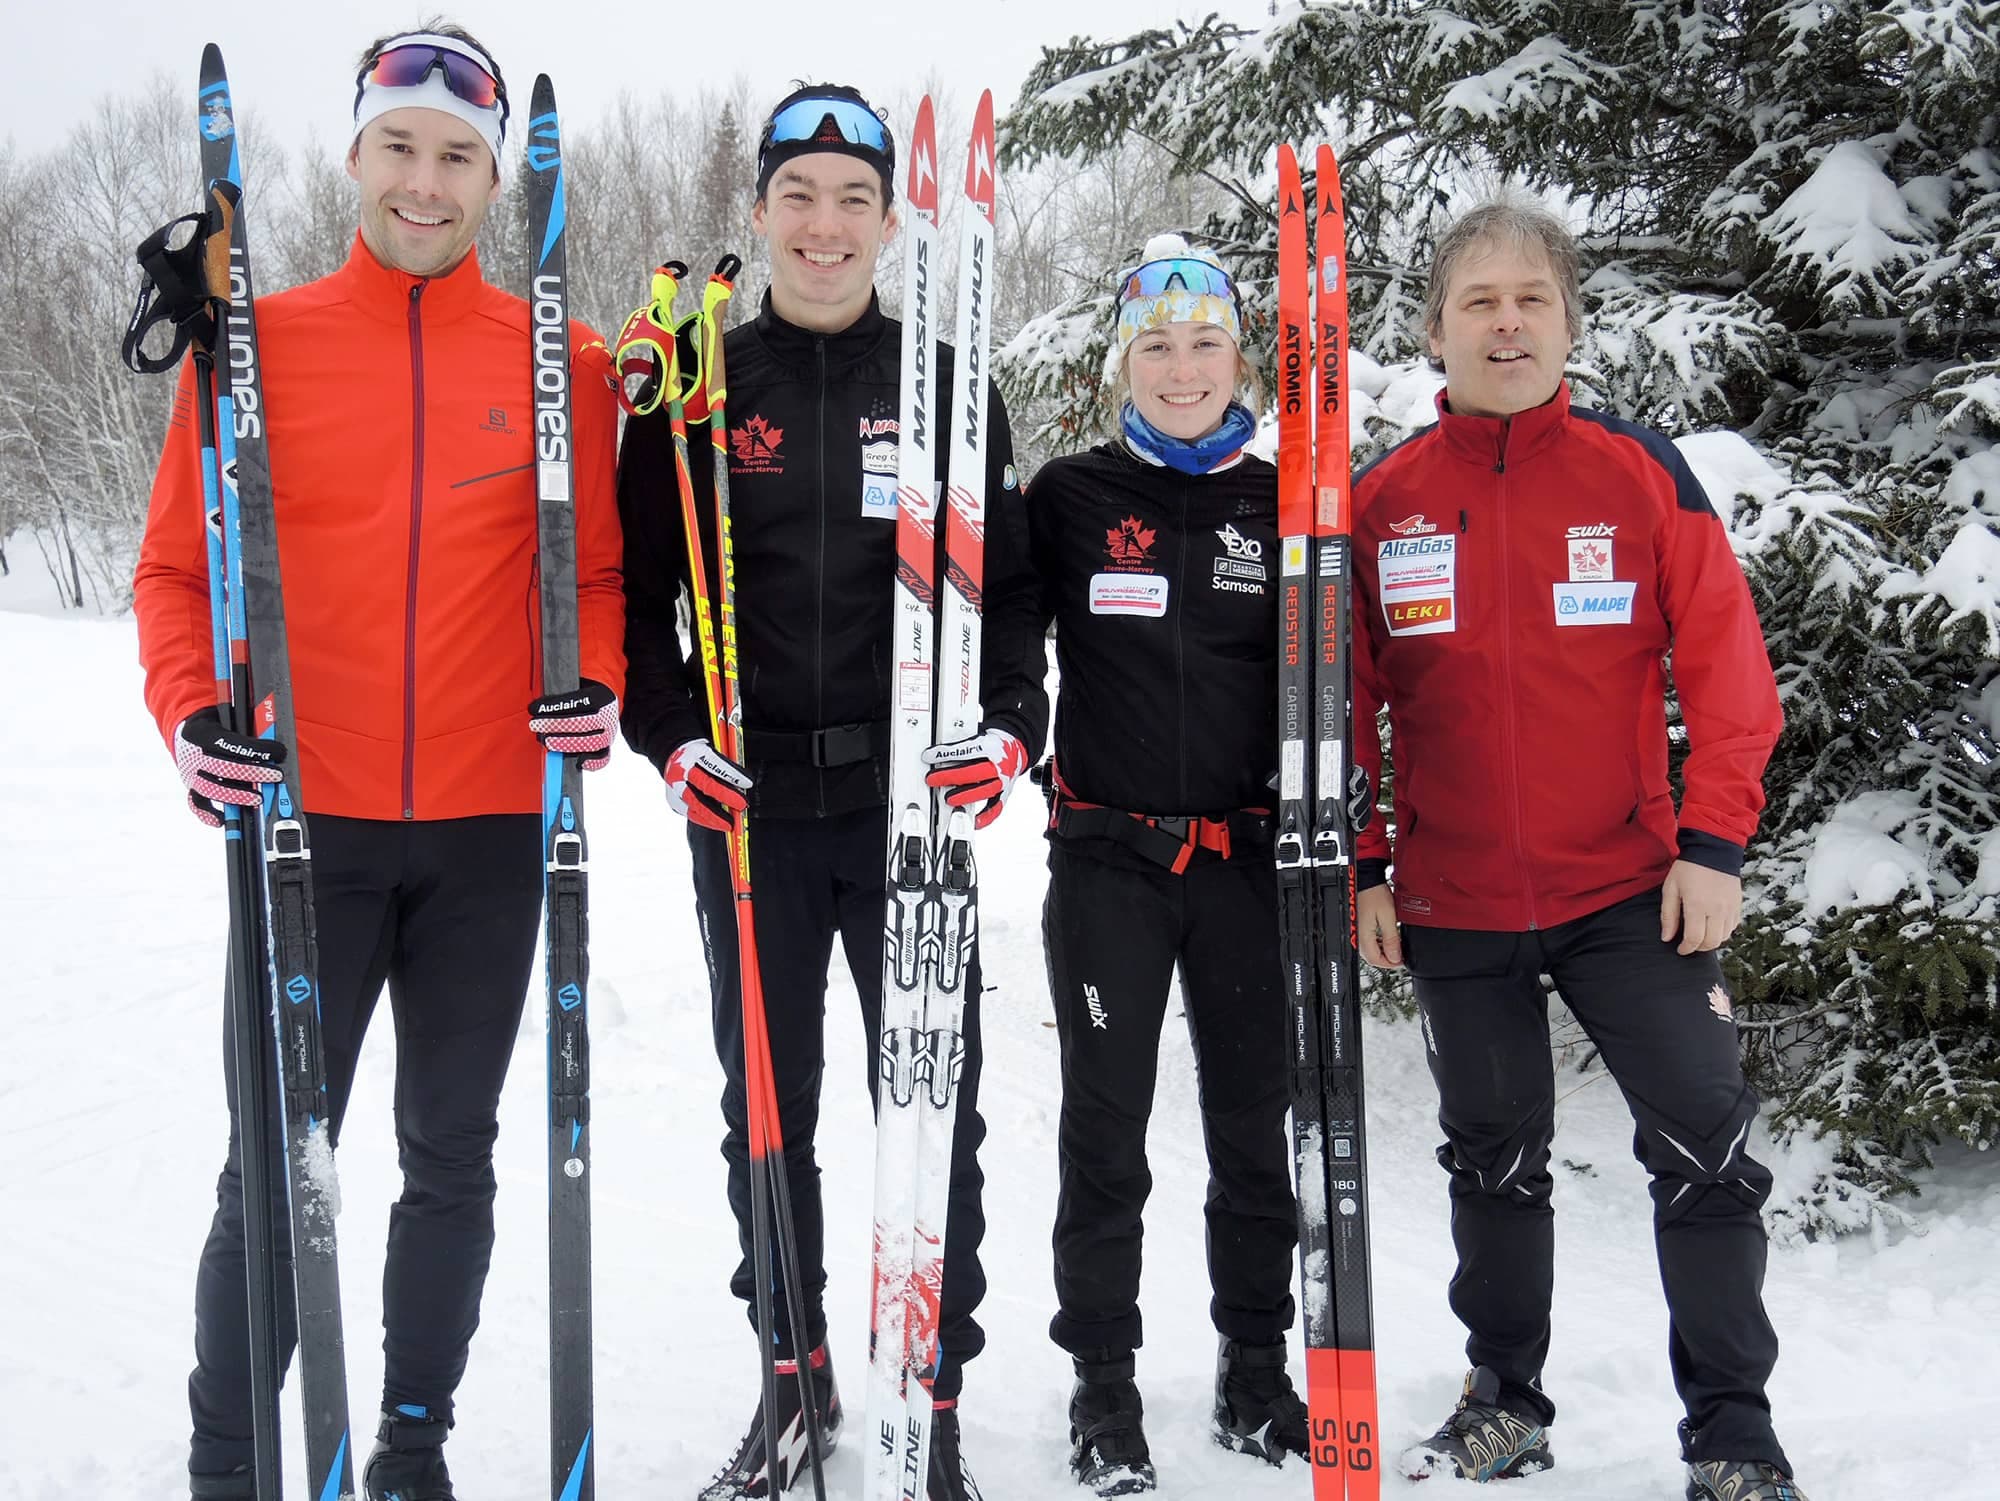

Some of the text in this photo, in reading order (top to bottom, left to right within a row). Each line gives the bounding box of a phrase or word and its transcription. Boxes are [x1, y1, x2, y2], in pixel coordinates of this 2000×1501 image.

[532, 275, 569, 462] salomon
[913, 237, 928, 452] MADSHUS
[965, 234, 984, 452] MADSHUS
[1286, 323, 1302, 415] ATOMIC
[1323, 323, 1339, 415] ATOMIC
[866, 452, 887, 462] Greg
[1227, 535, 1261, 557] EXO
[1380, 538, 1453, 557] AltaGas
[1212, 576, 1262, 594] Samson
[1582, 596, 1630, 612] MAPEI
[1286, 586, 1299, 666] REDSTER
[1323, 585, 1336, 664] REDSTER
[1394, 605, 1443, 620] LEKI
[721, 603, 738, 680] LEKI
[960, 622, 971, 707] REDLINE
[538, 700, 580, 713] Auclair
[1286, 686, 1297, 741] CARBON
[1323, 685, 1335, 740] CARBON
[214, 738, 258, 759] Auclair
[699, 755, 731, 779] Auclair
[935, 746, 976, 759] Auclair
[1347, 864, 1358, 950] ATOMIC
[1294, 962, 1302, 996] ATOMIC
[1330, 961, 1339, 994] ATOMIC
[1297, 1006, 1306, 1061] PROLINK
[1333, 1004, 1342, 1059] PROLINK
[1333, 1180, 1356, 1190] 180
[903, 1416, 920, 1500] LINE
[1313, 1417, 1338, 1468] S9
[1347, 1420, 1373, 1471] S9
